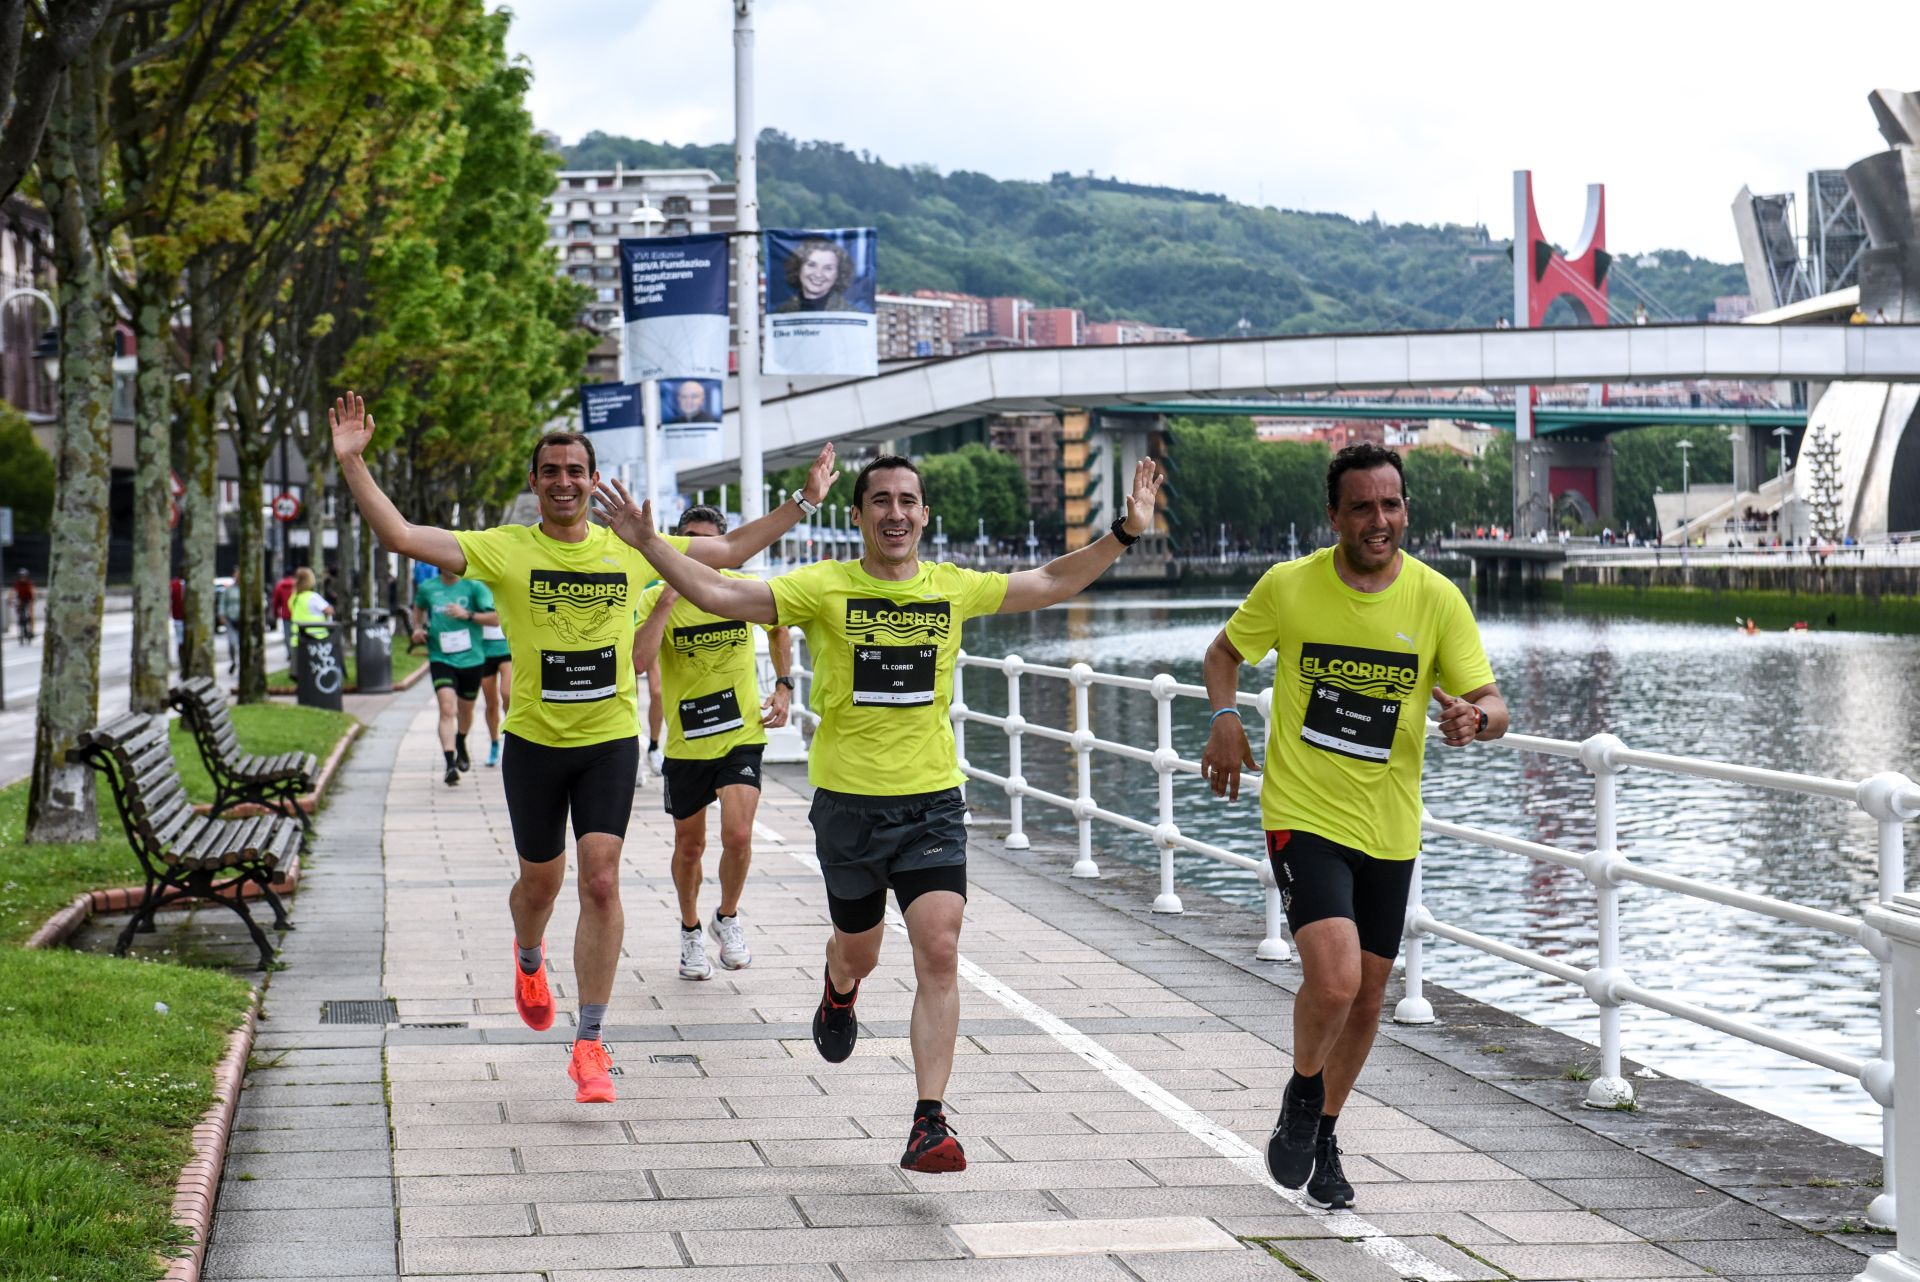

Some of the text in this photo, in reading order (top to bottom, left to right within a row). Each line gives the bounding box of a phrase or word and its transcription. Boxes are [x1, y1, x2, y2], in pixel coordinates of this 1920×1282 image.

[632, 259, 711, 272] BBVA Fundazioa
[632, 271, 693, 283] Ezagutzaren
[633, 282, 667, 294] Mugak
[633, 293, 663, 305] Sariak
[532, 581, 627, 597] EL CORREO
[849, 609, 950, 628] EL CORREO
[676, 628, 747, 647] EL CORREO
[600, 650, 613, 659] 163
[919, 650, 933, 658] 163
[1302, 657, 1416, 684] EL CORREO
[722, 692, 733, 700] 163
[1335, 707, 1372, 722] EL CORREO
[1382, 704, 1396, 714] 163
[1341, 726, 1357, 736] IGOR
